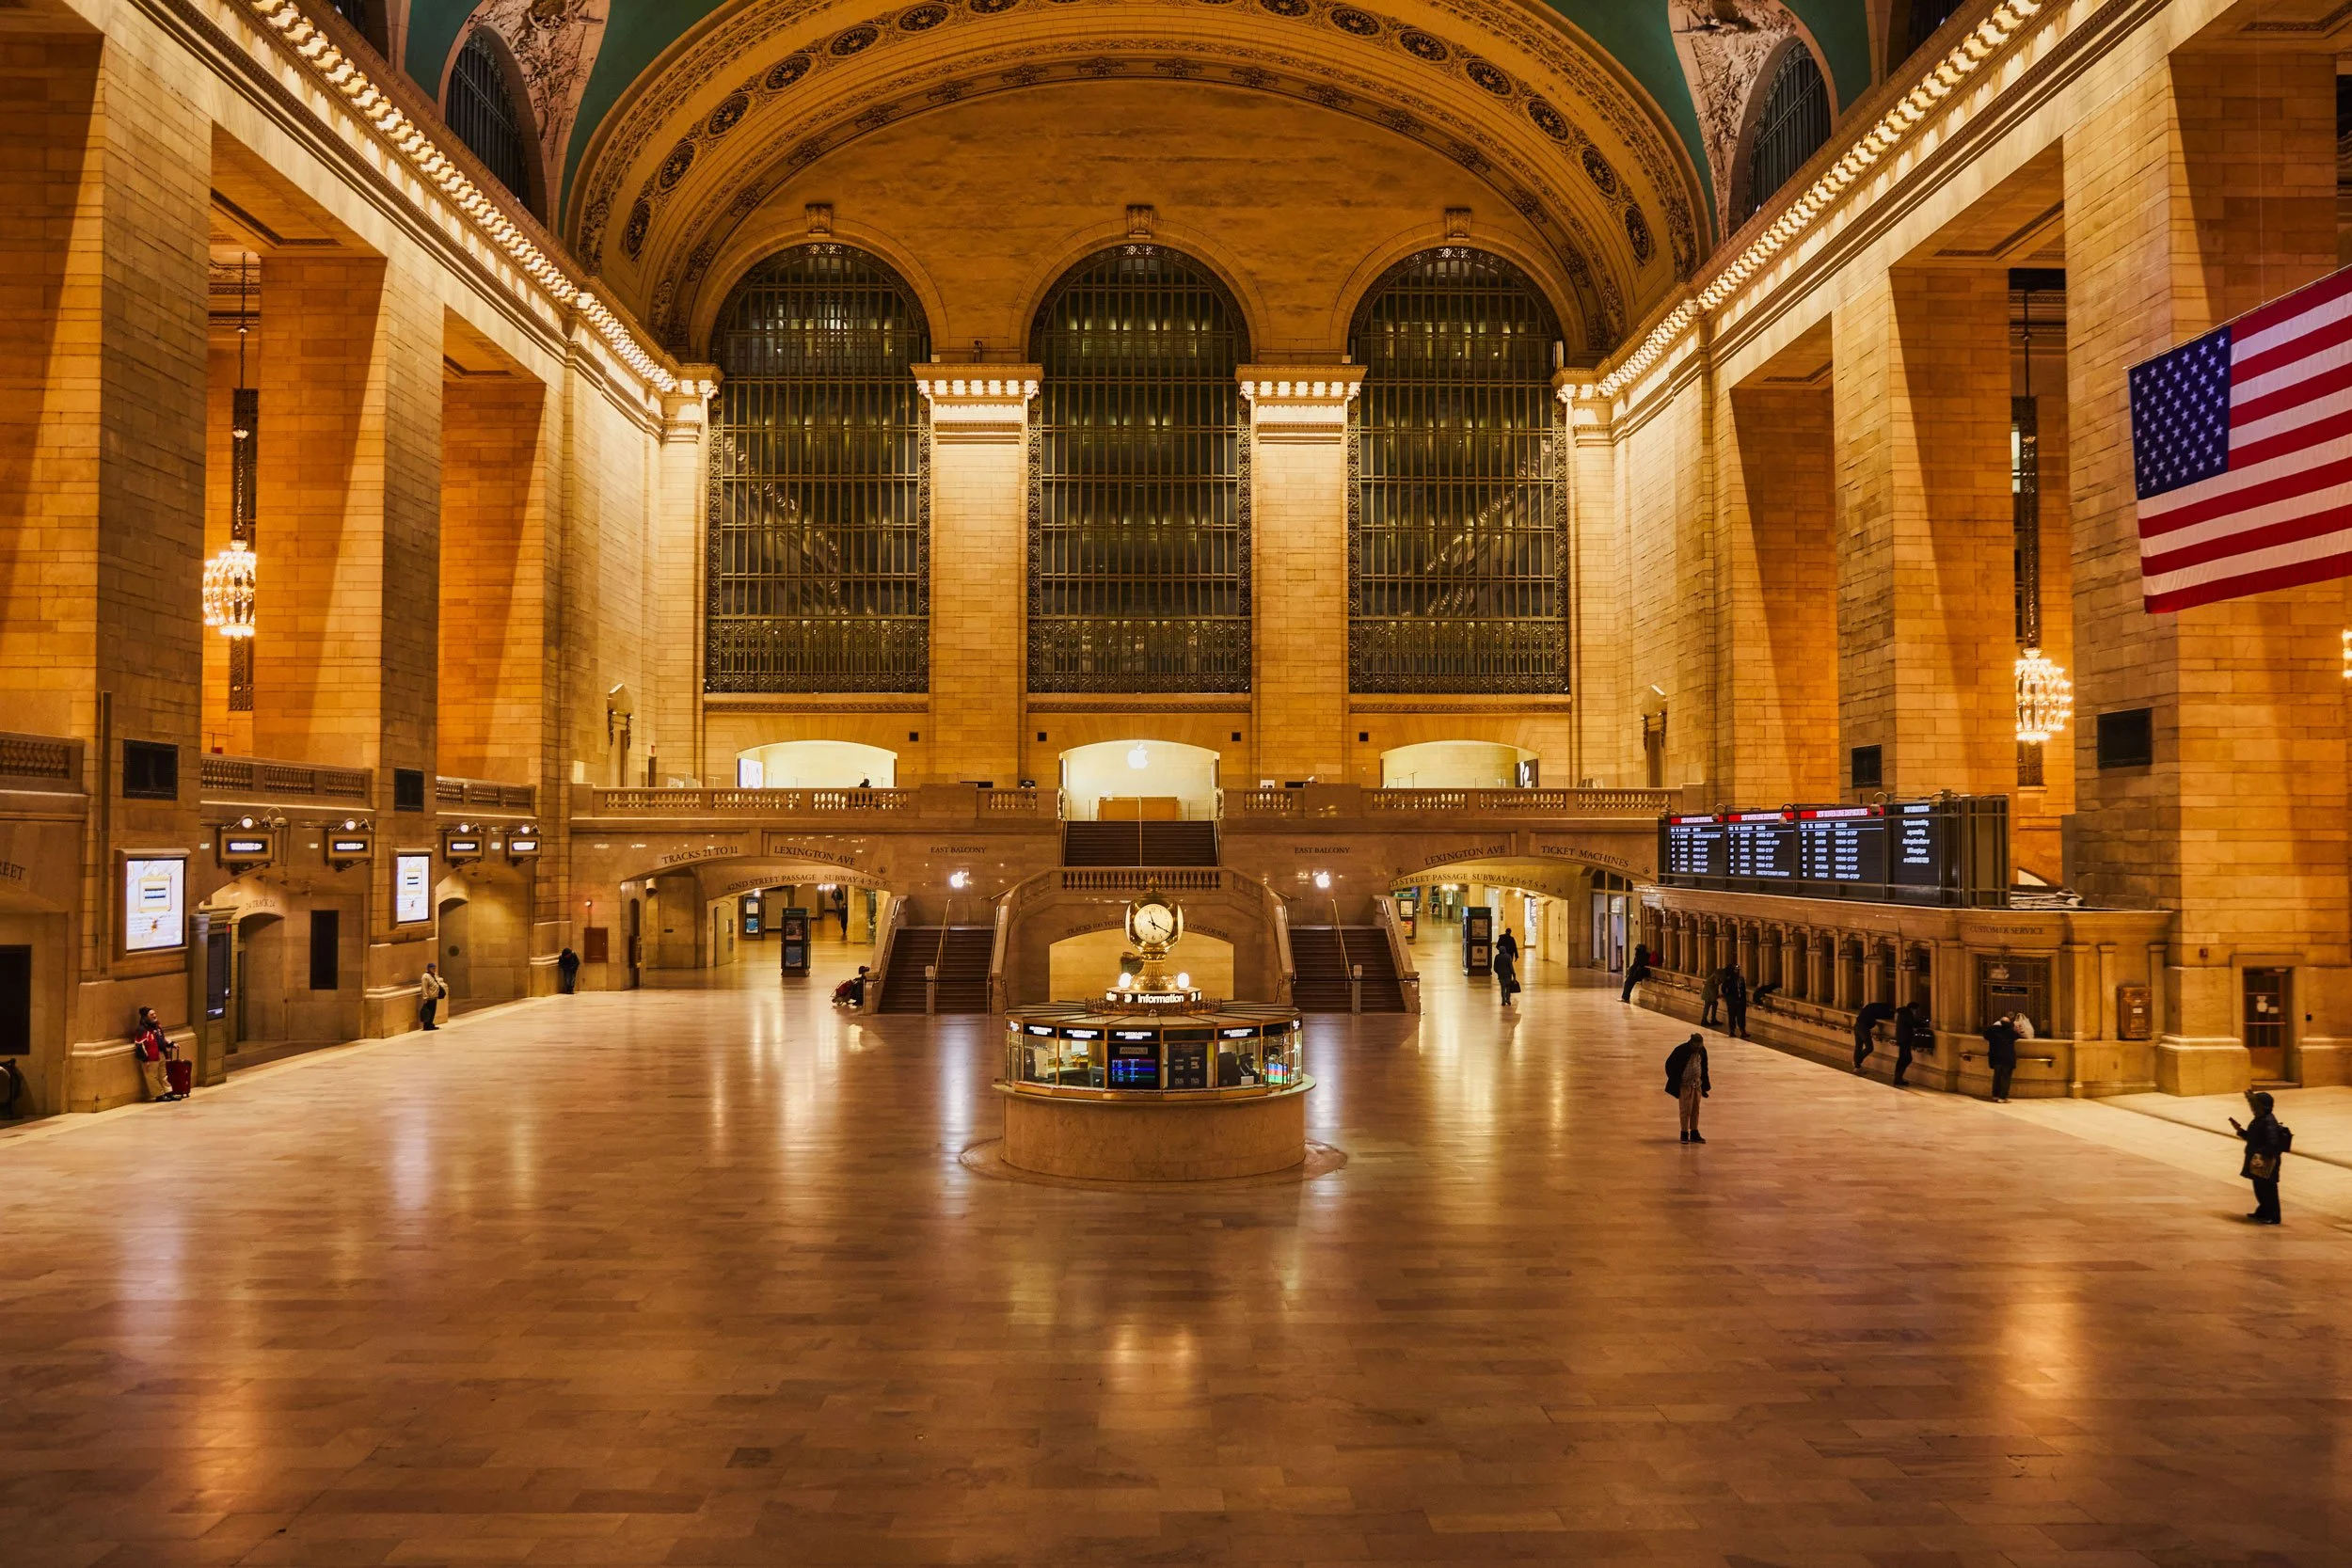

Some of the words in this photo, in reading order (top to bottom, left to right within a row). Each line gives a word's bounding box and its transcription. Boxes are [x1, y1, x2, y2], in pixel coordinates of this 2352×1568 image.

[661, 849, 701, 864] TRACKS
[703, 848, 711, 857] 21
[714, 846, 728, 855] TO
[773, 846, 834, 861] LEXINGTON
[836, 855, 856, 865] AVE
[1424, 847, 1484, 865] LEXINGTON
[1486, 845, 1506, 855] AVE
[1541, 846, 1576, 856] TICKET
[1579, 849, 1629, 866] MACHINES
[749, 876, 779, 887] STREET
[782, 874, 817, 882] PASSAGE
[824, 874, 858, 883] SUBWAY
[1400, 875, 1430, 885] STREET
[1433, 873, 1468, 881] PASSAGE
[1472, 873, 1507, 883] SUBWAY
[2010, 927, 2043, 935] SERVICE
[1137, 993, 1184, 1004] Information
